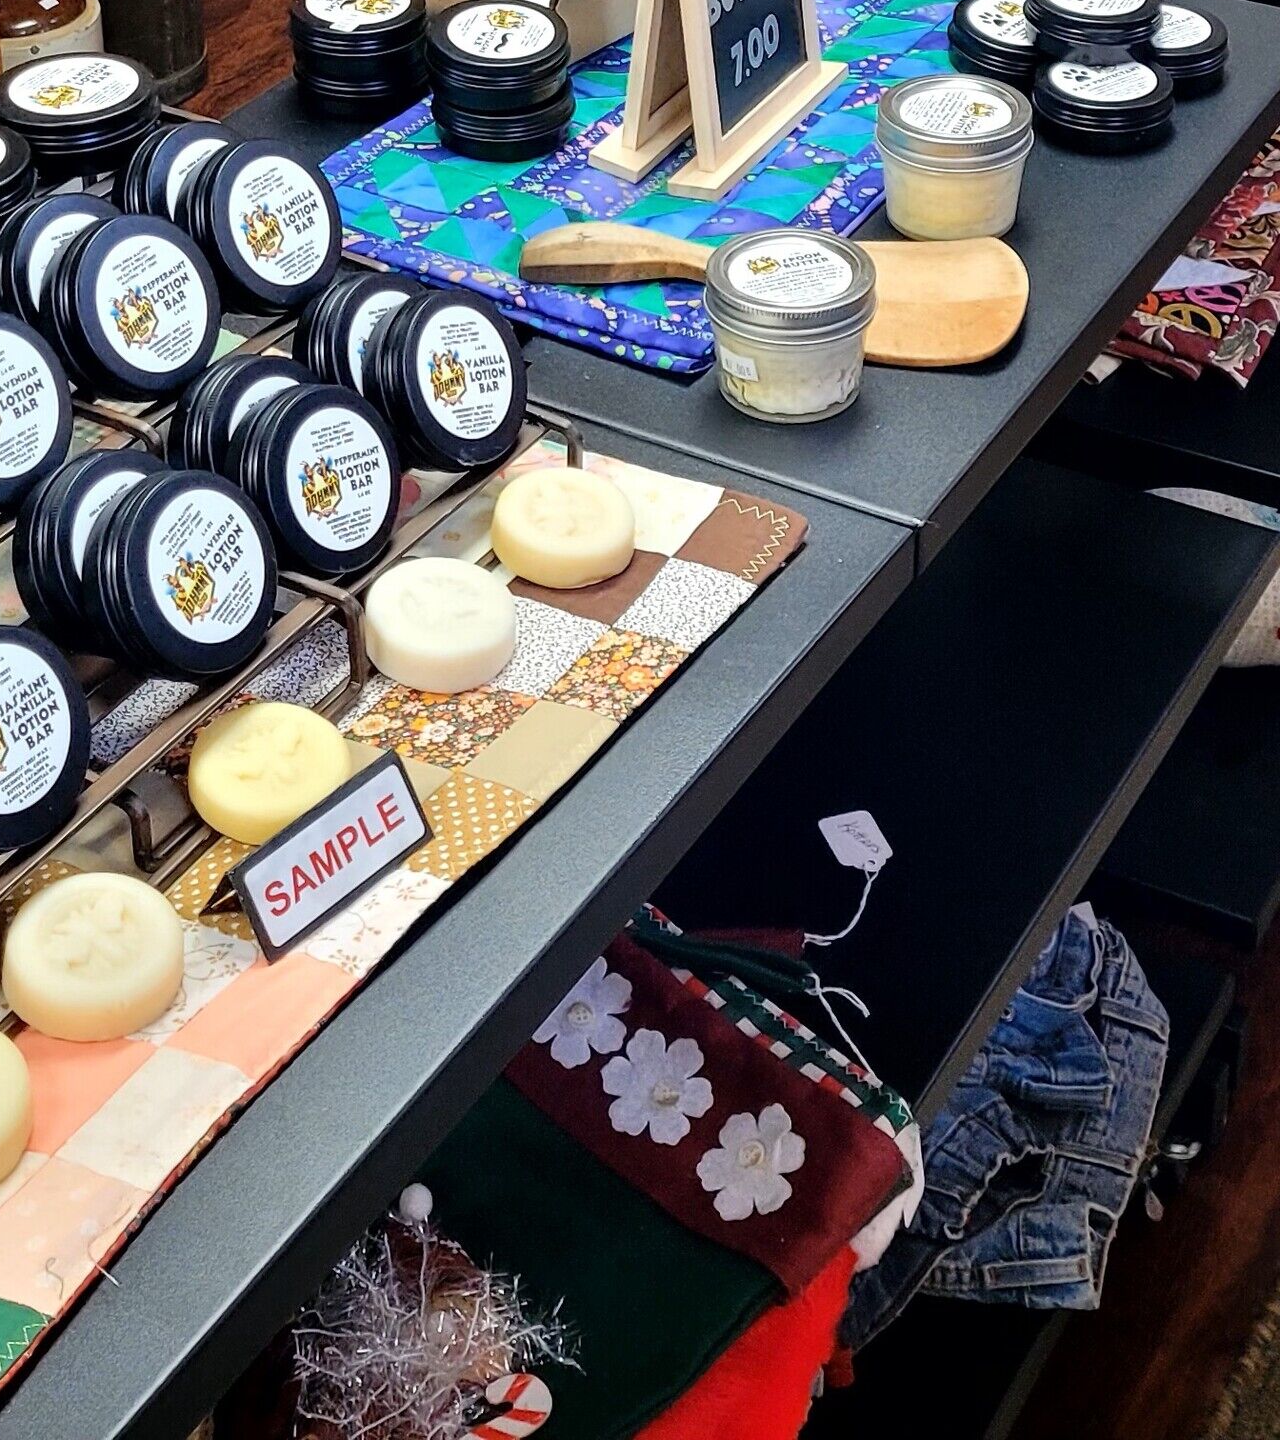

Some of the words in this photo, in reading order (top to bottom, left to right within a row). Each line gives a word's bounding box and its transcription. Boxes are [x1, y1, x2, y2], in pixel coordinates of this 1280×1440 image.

[731, 14, 779, 87] 7.00
[276, 190, 314, 215] VANILLA
[283, 200, 319, 228] LOTION
[294, 217, 315, 235] BAR
[782, 252, 822, 264] SPOON
[783, 257, 829, 268] BUTTER
[142, 260, 186, 293] PEPPERMINT
[151, 272, 190, 304] LOTION
[164, 290, 186, 311] BAR
[465, 355, 505, 368] VANILLA
[470, 368, 506, 382] LOTION
[479, 382, 499, 394] BAR
[0, 379, 45, 411] LOTION
[13, 398, 39, 419] BAR
[334, 446, 380, 466] PEPPERMINT
[340, 458, 380, 480] LOTION
[351, 475, 373, 491] BAR
[199, 514, 235, 560] LAVENDAR
[207, 524, 244, 572] LOTION
[221, 546, 244, 574] BAR
[2, 687, 55, 727] VANILLA
[10, 700, 60, 743] LOTION
[26, 723, 54, 750] BAR
[264, 793, 405, 917] SAMPLE
